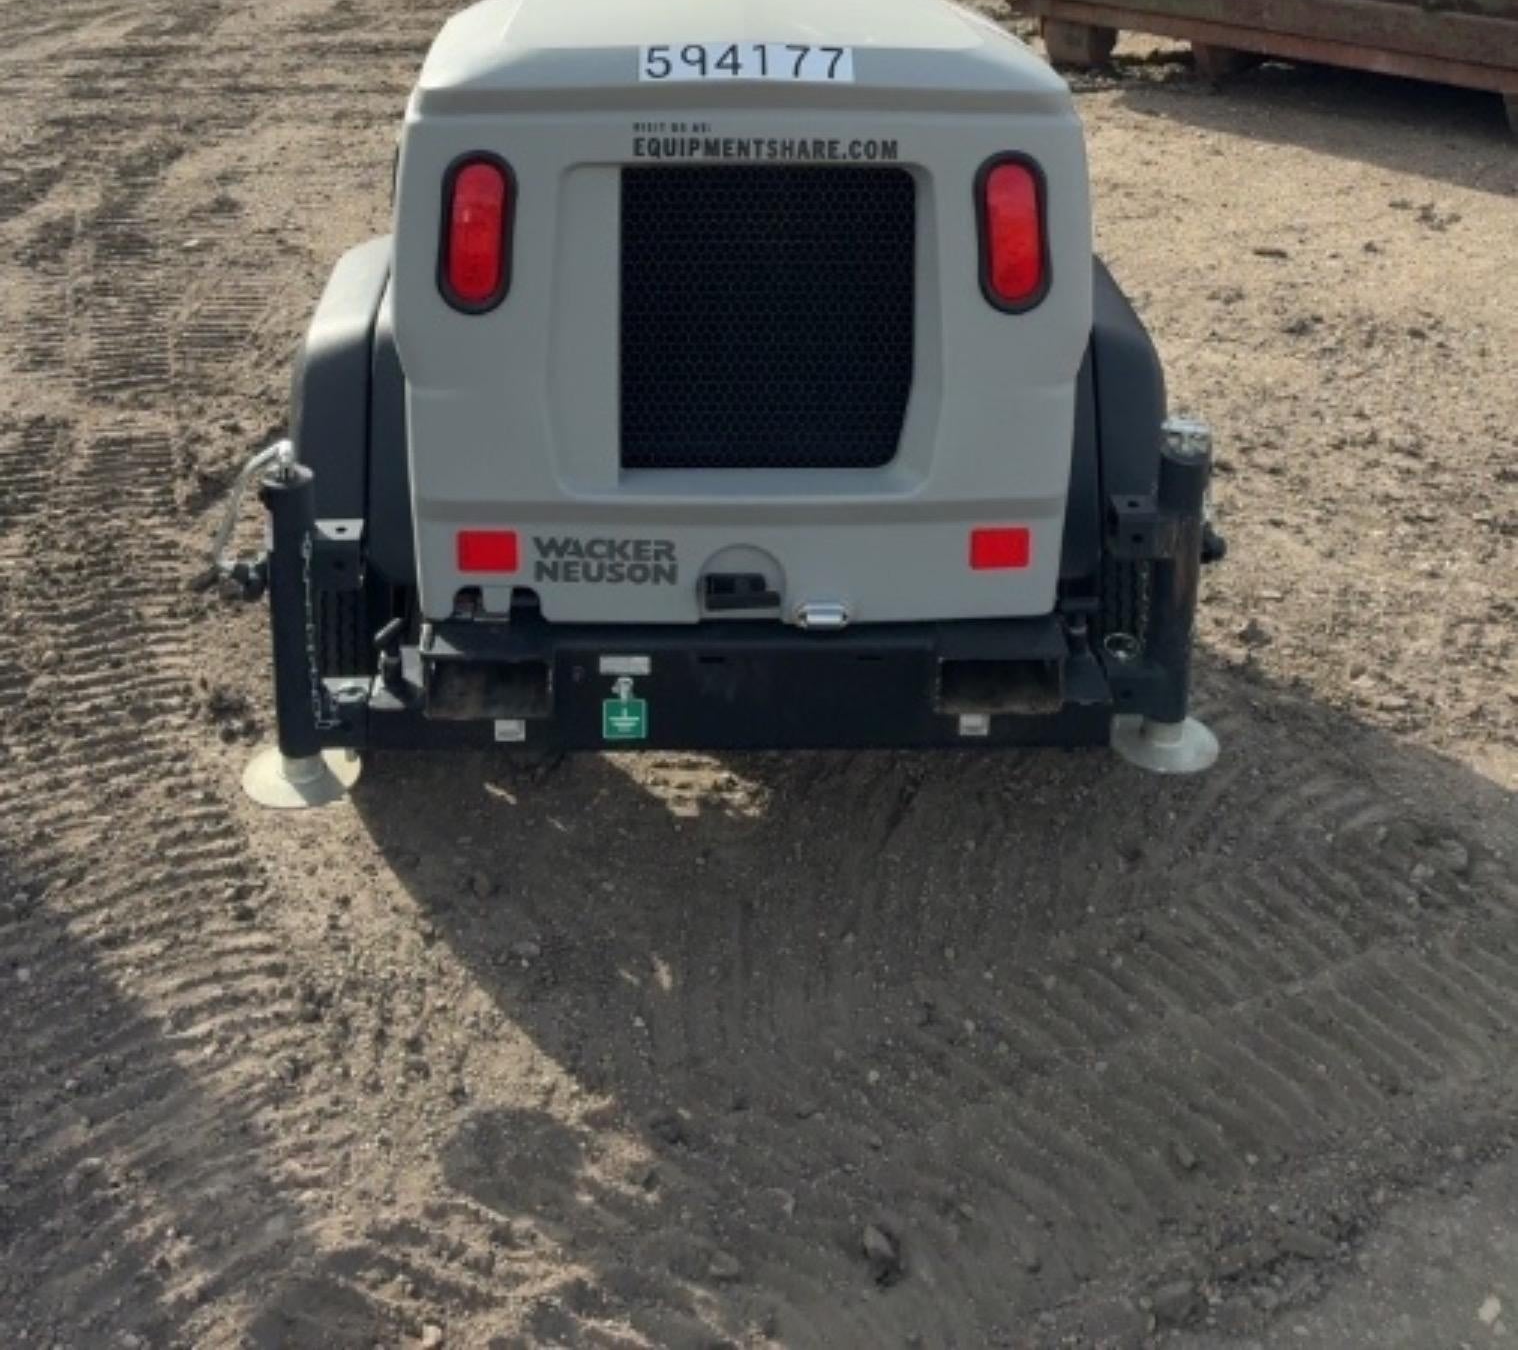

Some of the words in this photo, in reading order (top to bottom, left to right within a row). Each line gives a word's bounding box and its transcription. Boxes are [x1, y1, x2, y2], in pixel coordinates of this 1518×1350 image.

[645, 44, 845, 79] 594177
[633, 137, 899, 160] EQUIPMENTSHARE.COM
[532, 536, 677, 562] WACKER
[534, 560, 679, 586] NEUSON
